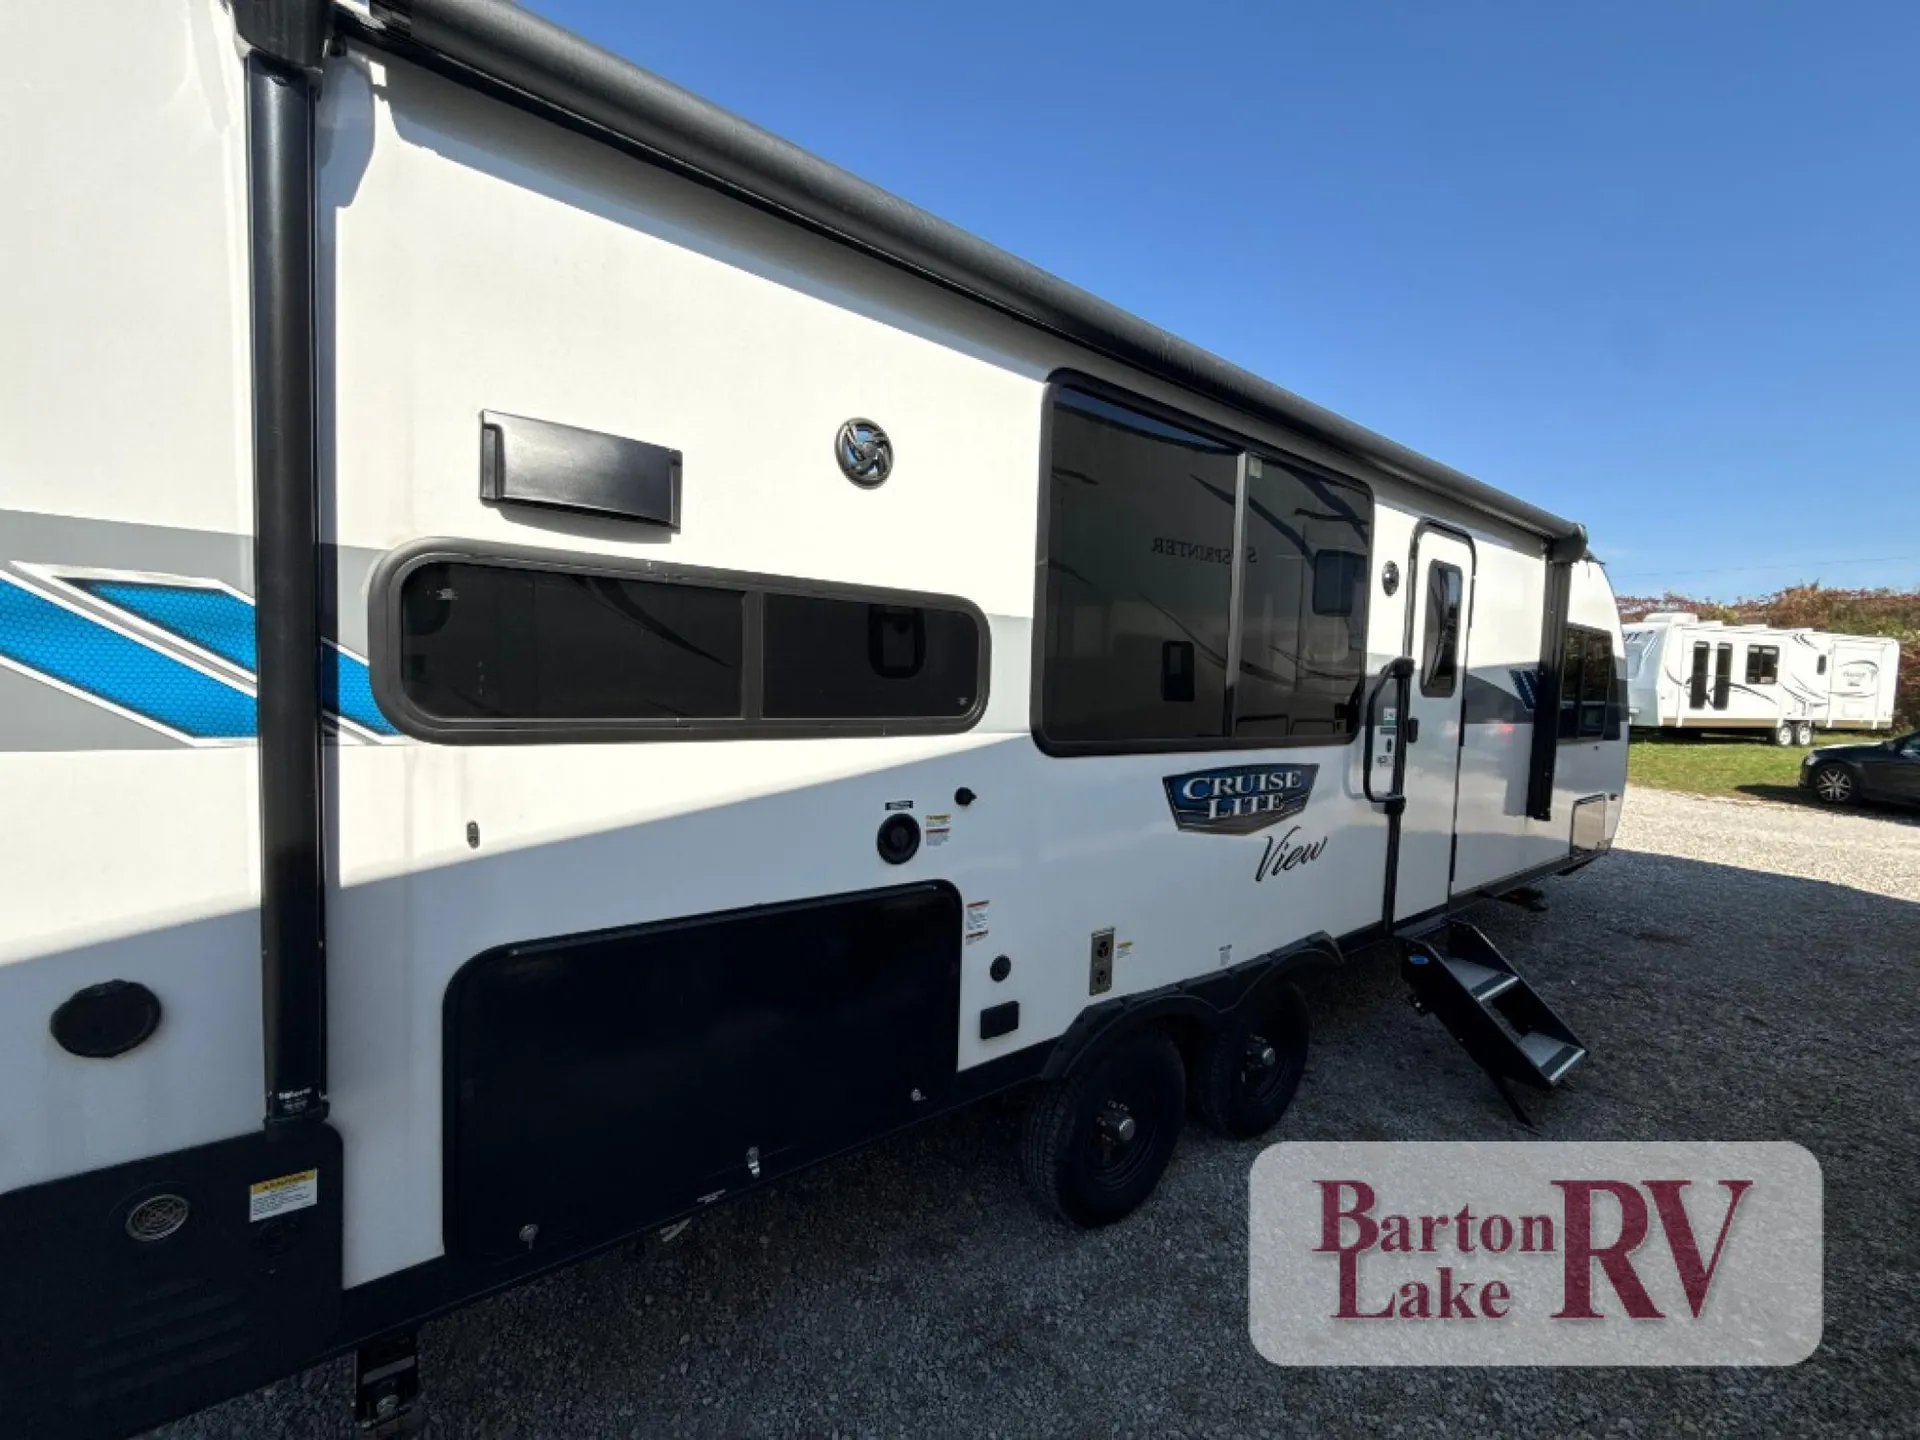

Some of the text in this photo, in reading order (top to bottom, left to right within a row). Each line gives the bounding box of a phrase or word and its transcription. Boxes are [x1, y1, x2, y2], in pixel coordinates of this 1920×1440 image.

[1182, 770, 1303, 801] CRUISE
[1208, 793, 1285, 820] LITE
[1255, 825, 1329, 883] View
